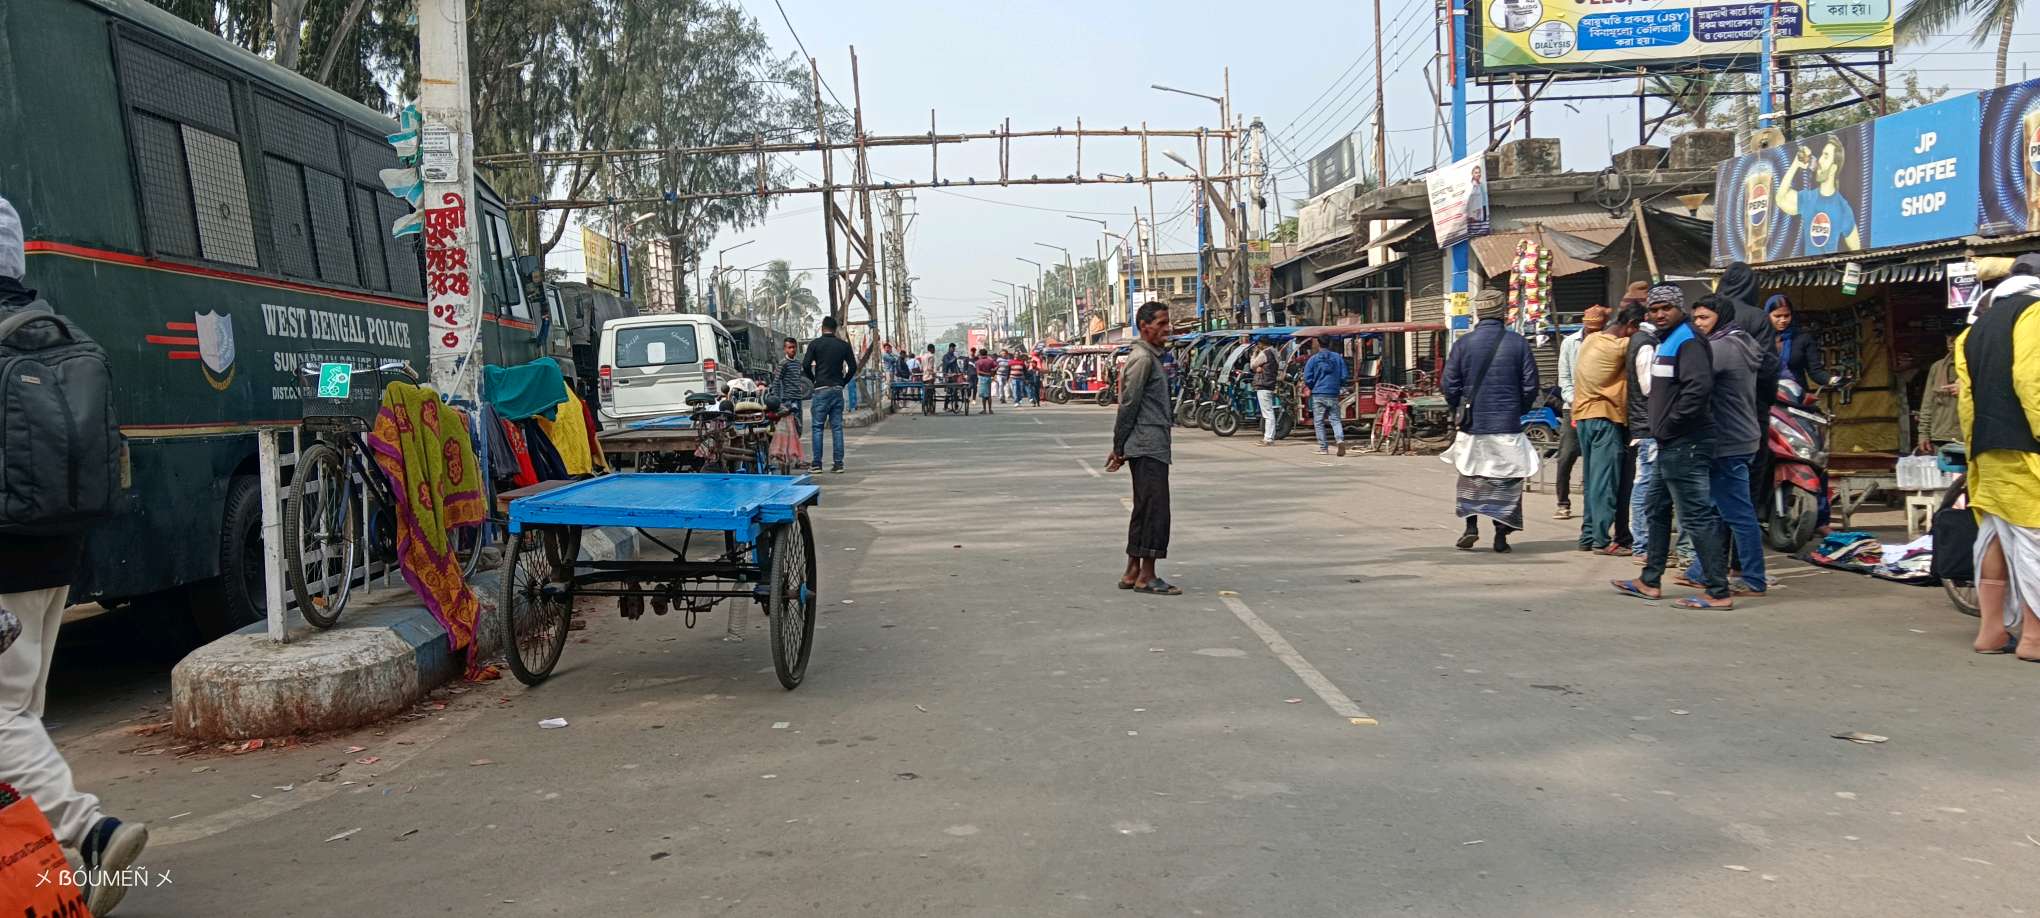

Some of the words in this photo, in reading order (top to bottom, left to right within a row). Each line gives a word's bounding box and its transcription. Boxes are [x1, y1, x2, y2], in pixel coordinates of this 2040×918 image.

[1657, 12, 1690, 23] (JSY)
[1826, 4, 1848, 16] করা
[1535, 40, 1571, 49] DIALYSIS
[1914, 131, 1937, 154] JP
[1894, 157, 1957, 188] COFFEE
[1901, 191, 1946, 217] SHOP
[1811, 225, 1829, 235] PEPSI
[261, 303, 307, 338] WEST
[309, 309, 366, 343] BENGAL
[366, 317, 411, 348] POLICE
